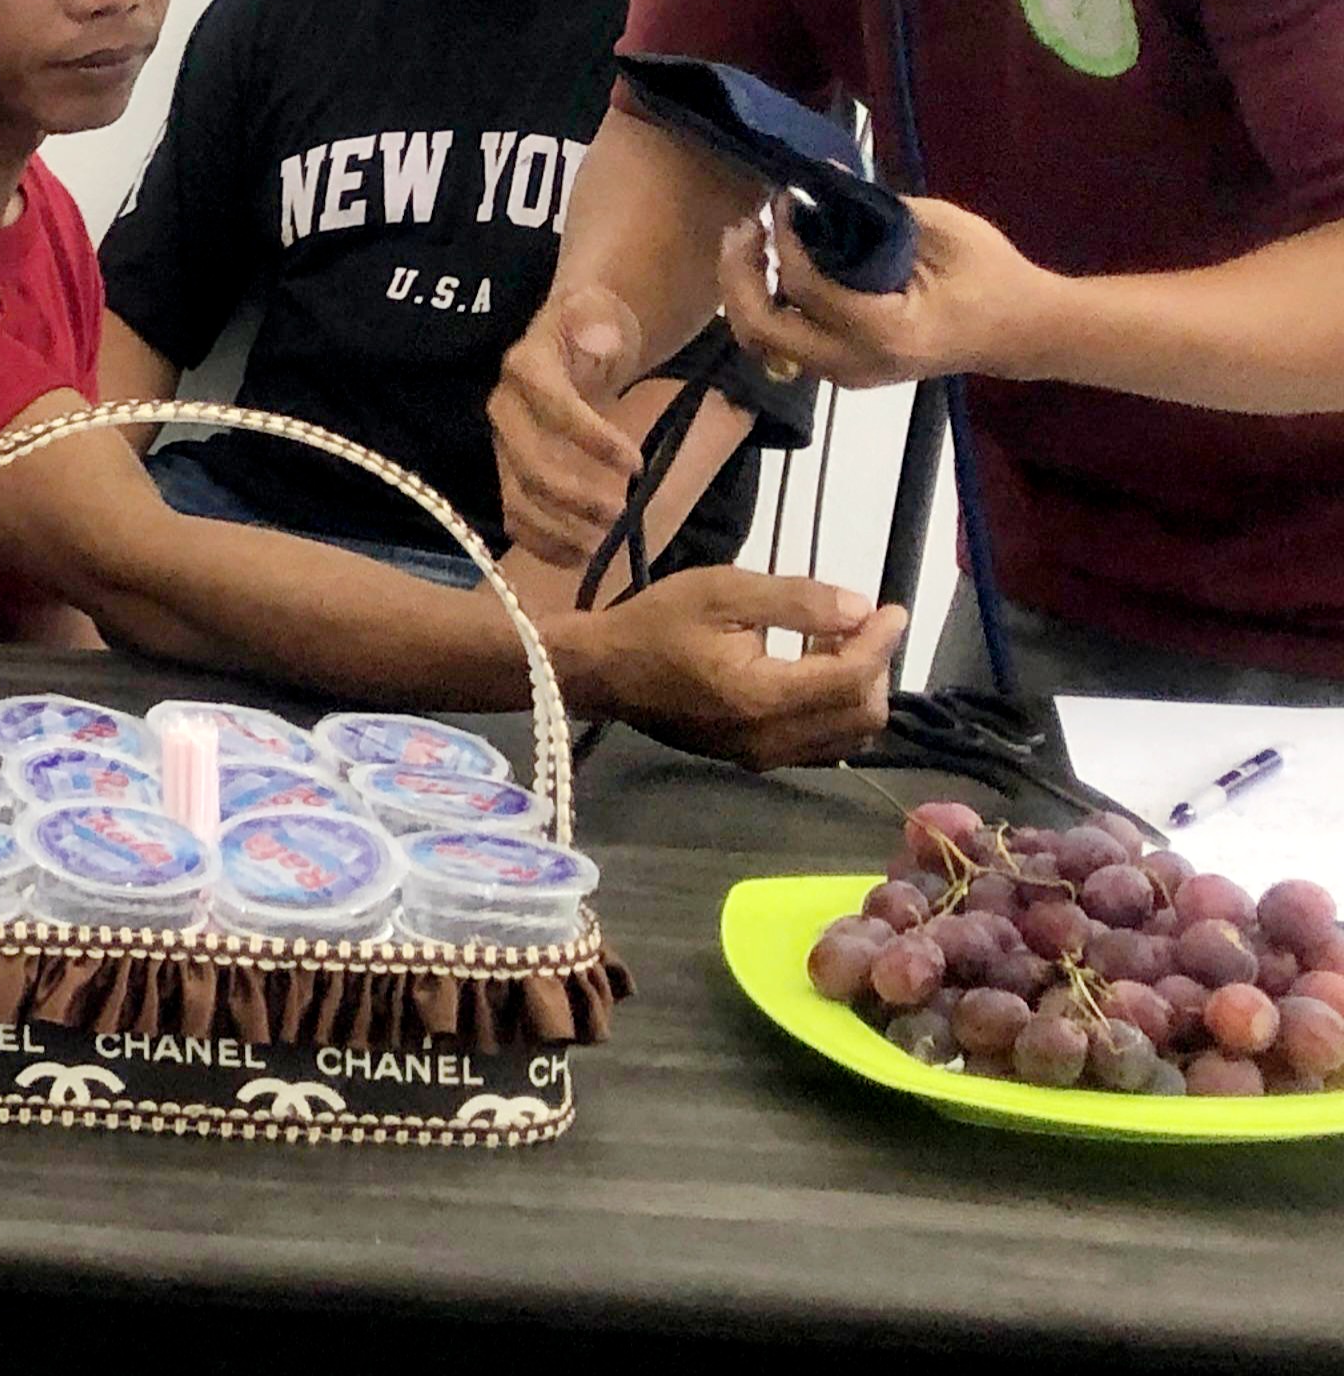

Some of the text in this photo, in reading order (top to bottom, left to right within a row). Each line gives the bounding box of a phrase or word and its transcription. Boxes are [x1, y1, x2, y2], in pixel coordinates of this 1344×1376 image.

[280, 129, 591, 250] NEW YO
[95, 1032, 267, 1070] CHANEL
[316, 1046, 485, 1087] CHANEL
